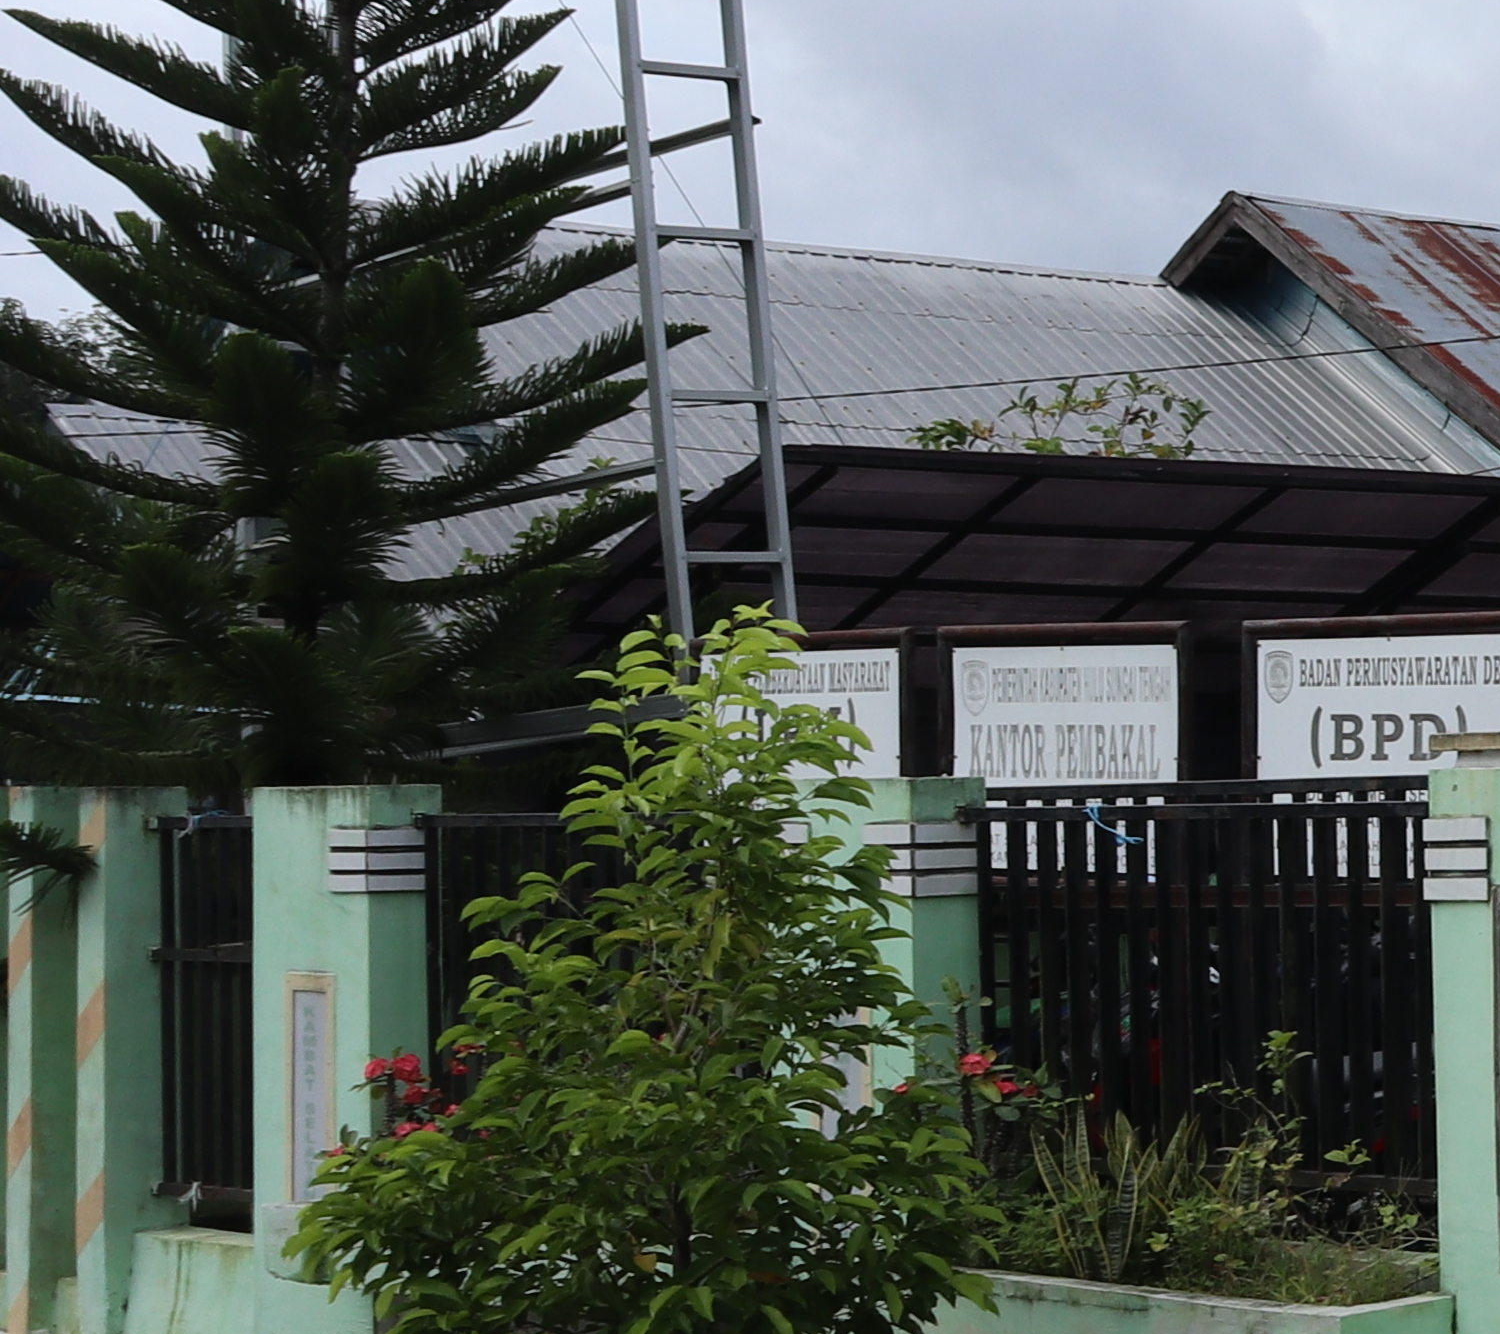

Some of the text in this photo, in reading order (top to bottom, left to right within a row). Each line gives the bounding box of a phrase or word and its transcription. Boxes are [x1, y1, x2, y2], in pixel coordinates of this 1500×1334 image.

[1299, 658, 1341, 687] BADAN
[1346, 656, 1478, 687] PERMUSYAWARATAN
[969, 723, 1162, 780] KANTOR PEMBAKAL
